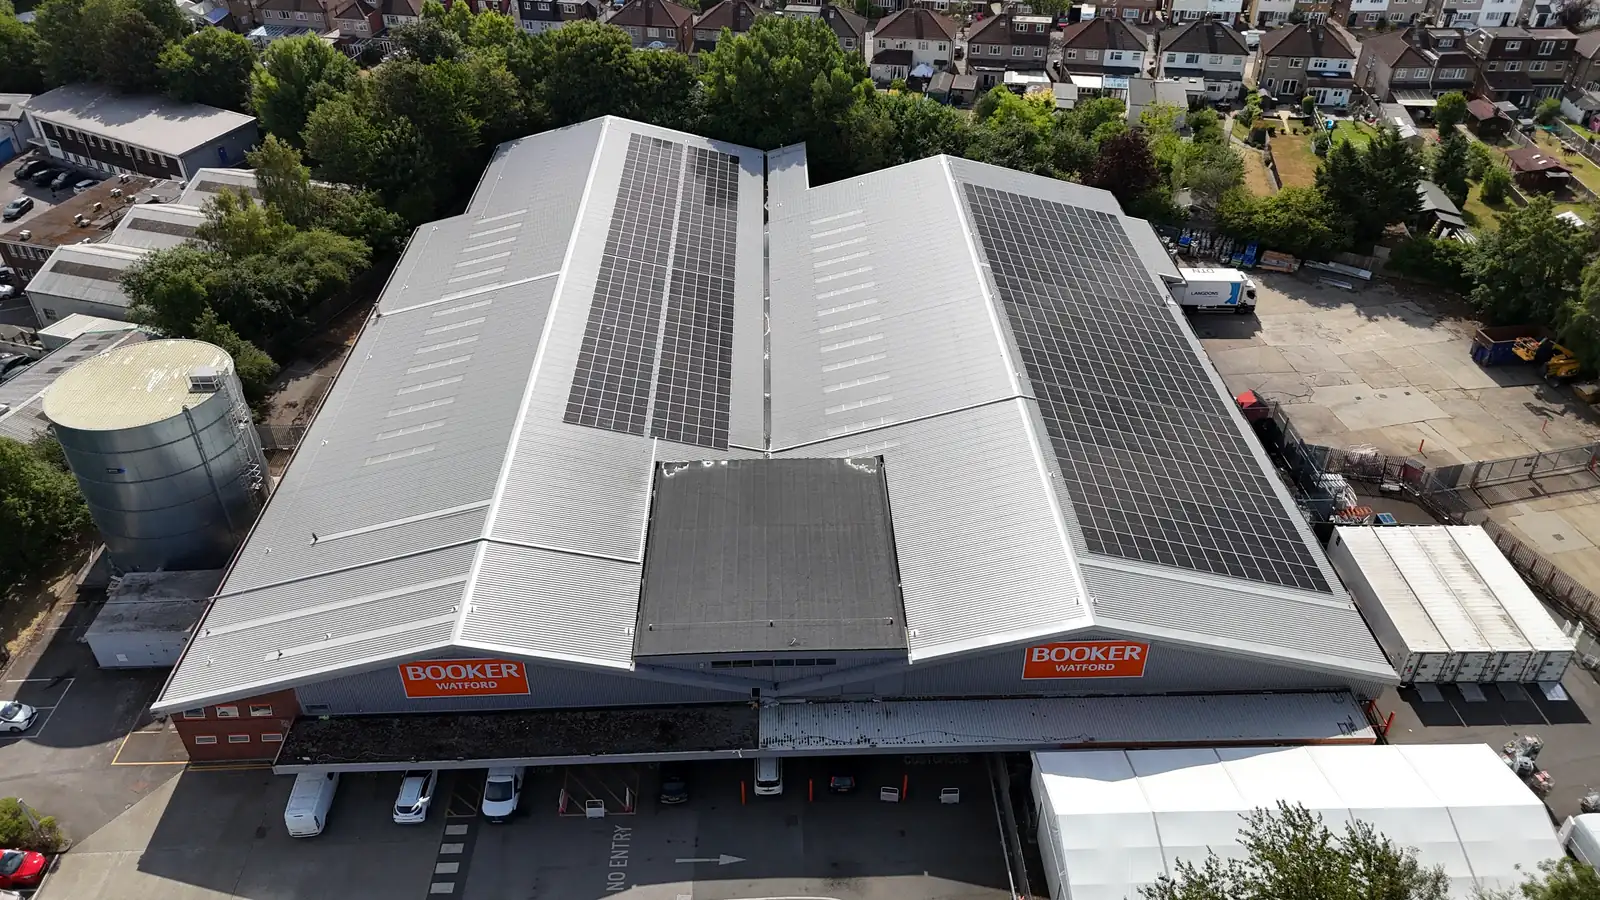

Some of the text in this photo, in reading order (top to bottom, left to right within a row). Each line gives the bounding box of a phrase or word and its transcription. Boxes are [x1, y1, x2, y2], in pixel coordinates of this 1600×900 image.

[1032, 646, 1142, 662] BOOKER
[405, 663, 521, 681] BOOKER
[1055, 663, 1115, 672] WATFORD
[436, 681, 498, 690] WATFORD
[606, 824, 632, 891] NO ENTRY
